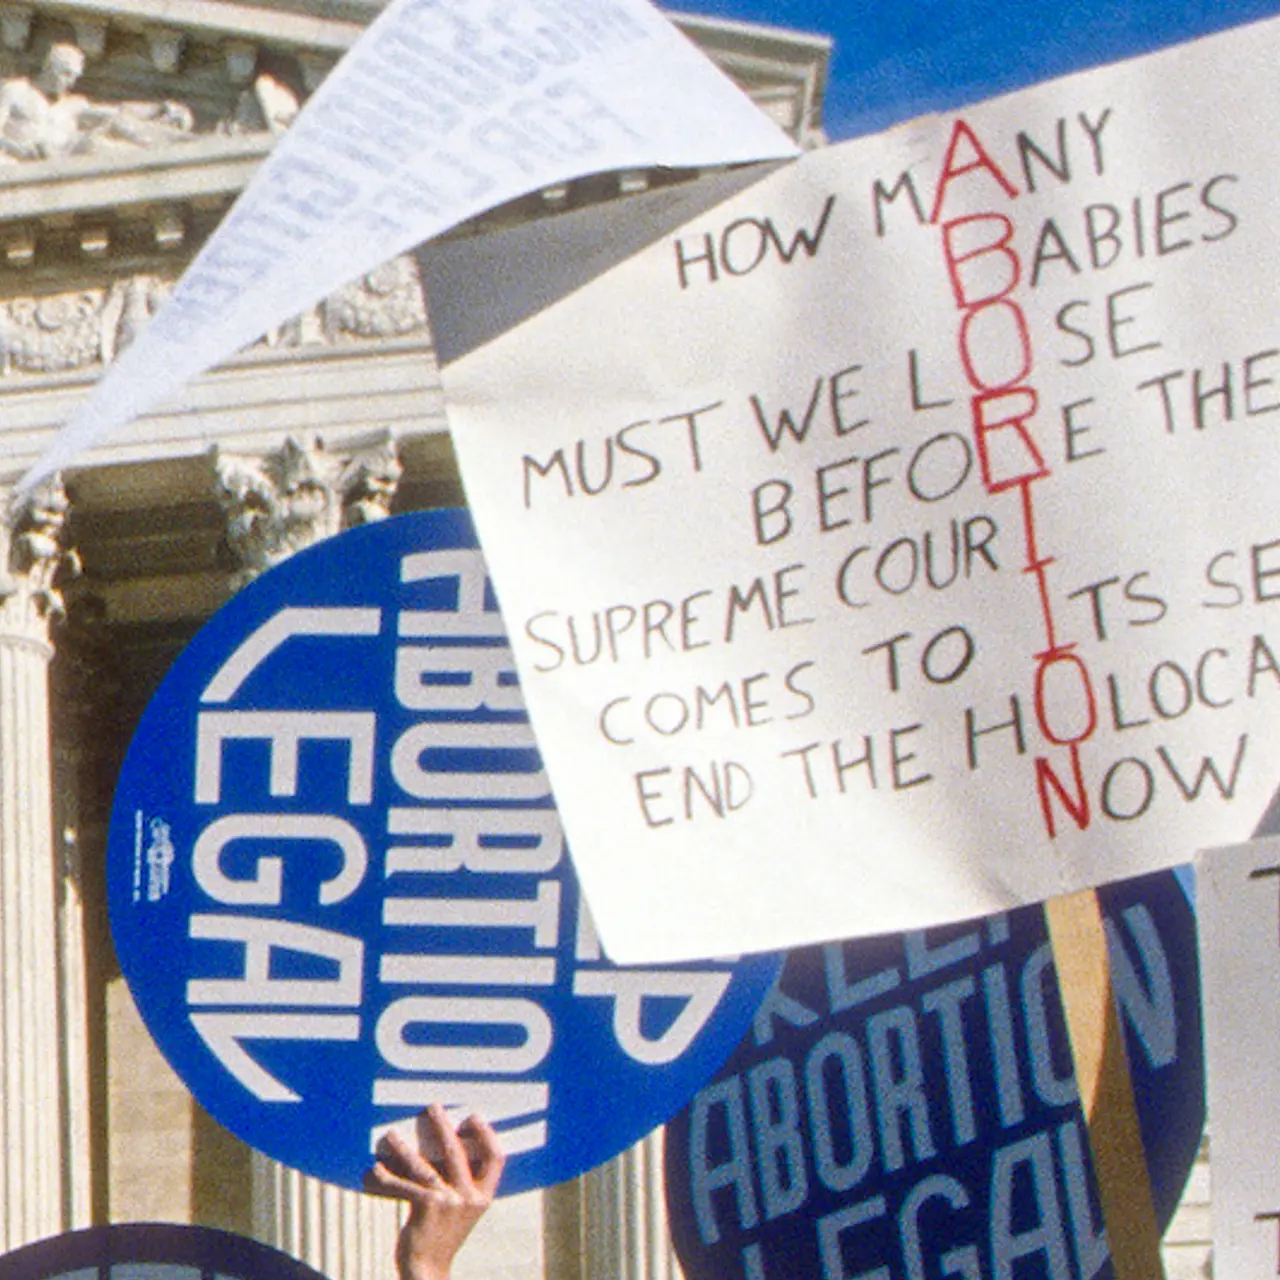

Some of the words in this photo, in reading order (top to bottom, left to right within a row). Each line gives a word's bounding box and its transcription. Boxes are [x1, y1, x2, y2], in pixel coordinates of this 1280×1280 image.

[672, 194, 837, 290] HOW
[869, 108, 1117, 240] MANY
[942, 174, 1242, 312] BABIES
[520, 400, 722, 511] MUST
[749, 363, 871, 455] WE
[909, 280, 1164, 412] LOSE
[750, 386, 1106, 549] BEFORE
[522, 563, 819, 674] SUPREME
[599, 660, 819, 748] COMES
[861, 624, 977, 694] TO
[633, 757, 755, 830] END
[781, 722, 934, 806] THE
[1033, 730, 1249, 842] NOW
[184, 606, 384, 1104] LEGAL
[687, 902, 1178, 1246] ABORTION
